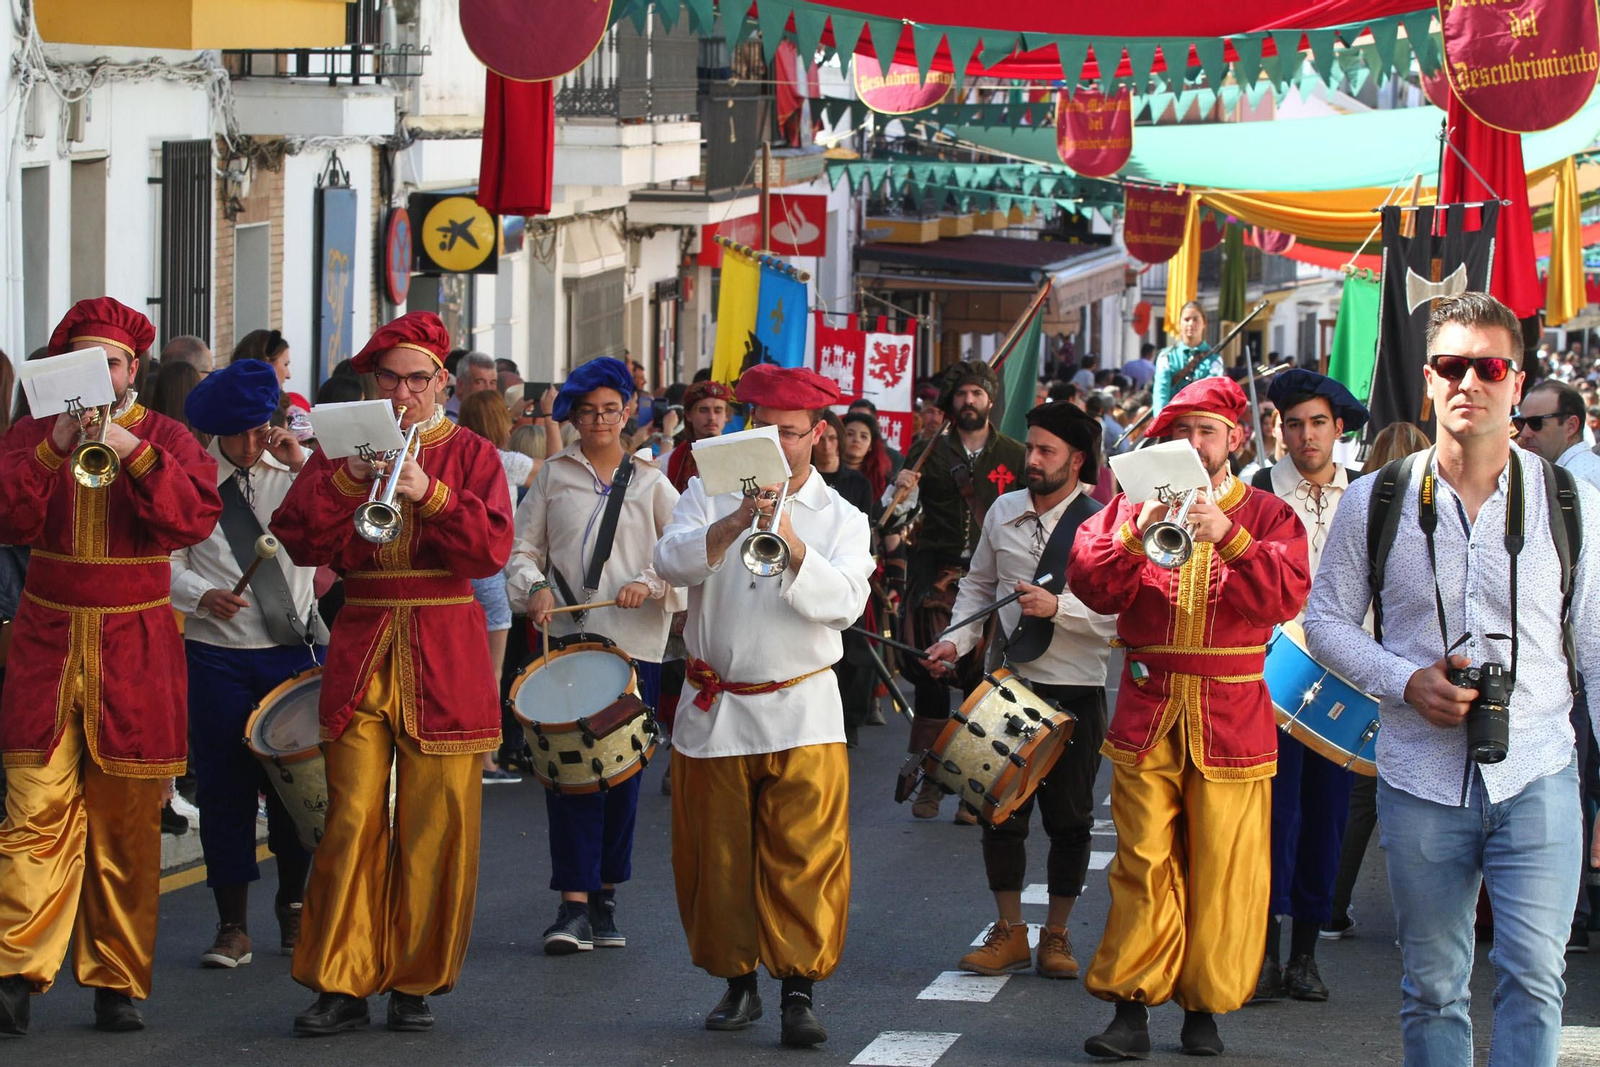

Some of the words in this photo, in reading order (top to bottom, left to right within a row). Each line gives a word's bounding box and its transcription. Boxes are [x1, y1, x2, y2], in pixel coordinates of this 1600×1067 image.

[1508, 9, 1539, 39] del
[1453, 46, 1598, 91] Descubrimiento
[1423, 475, 1431, 504] Nikon
